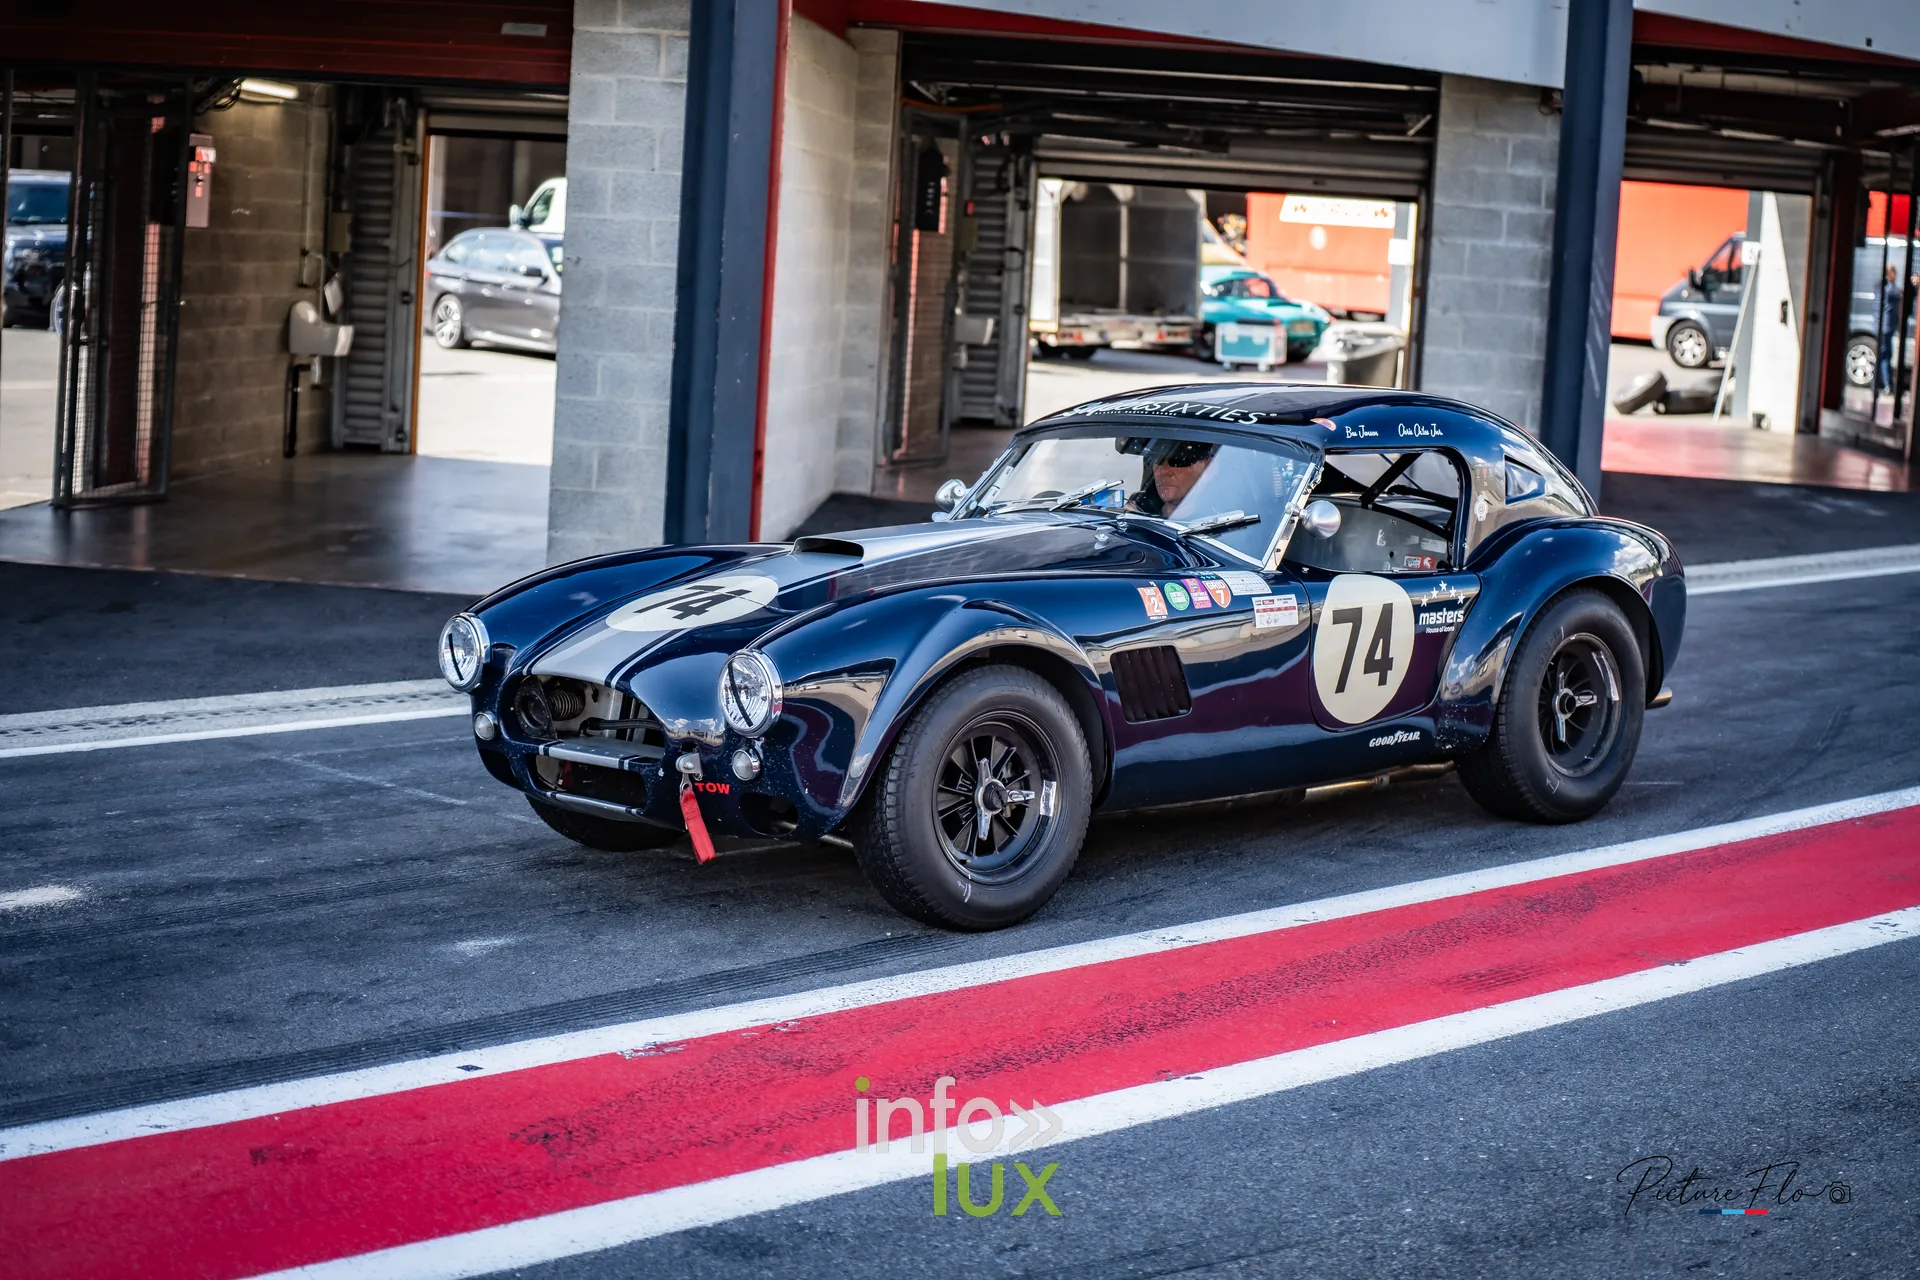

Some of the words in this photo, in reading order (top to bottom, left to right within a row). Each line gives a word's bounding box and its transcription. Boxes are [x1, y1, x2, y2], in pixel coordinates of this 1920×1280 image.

[632, 585, 752, 621] 74
[1216, 589, 1225, 604] 7
[1150, 597, 1161, 614] 2
[1419, 607, 1464, 625] masters
[1332, 602, 1394, 694] 74
[1369, 730, 1420, 747] GOODYEAR
[694, 782, 731, 795] TOW
